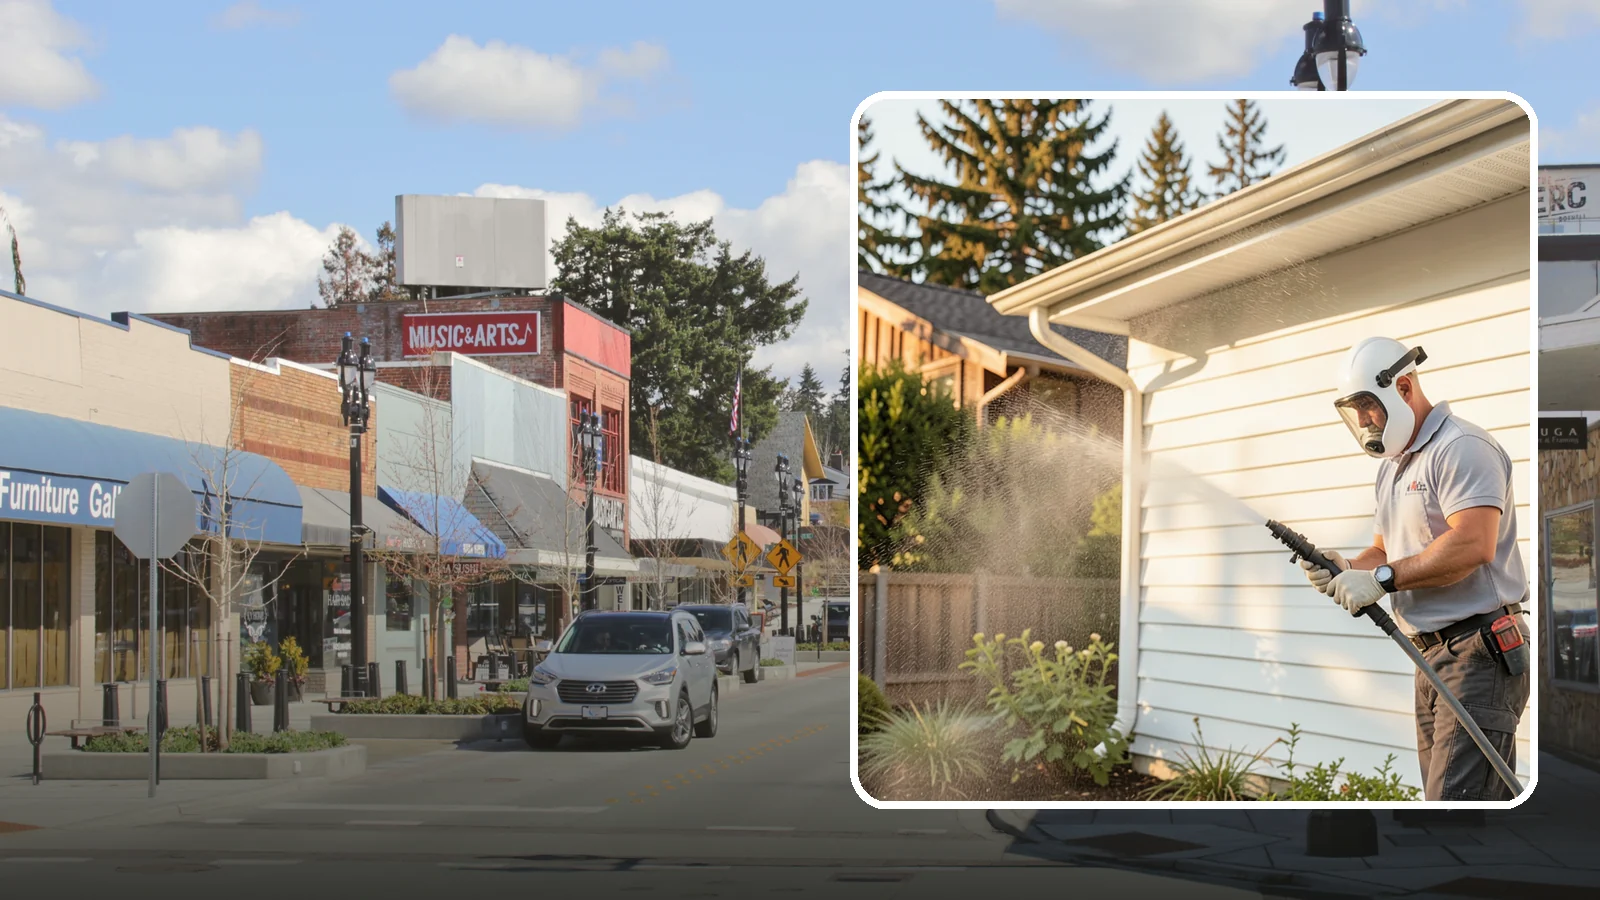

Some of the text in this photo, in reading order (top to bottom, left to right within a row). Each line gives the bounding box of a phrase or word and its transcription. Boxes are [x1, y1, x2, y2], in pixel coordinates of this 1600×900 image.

[0, 471, 122, 519] Furniture Gal
[453, 563, 479, 575] SUSHI
